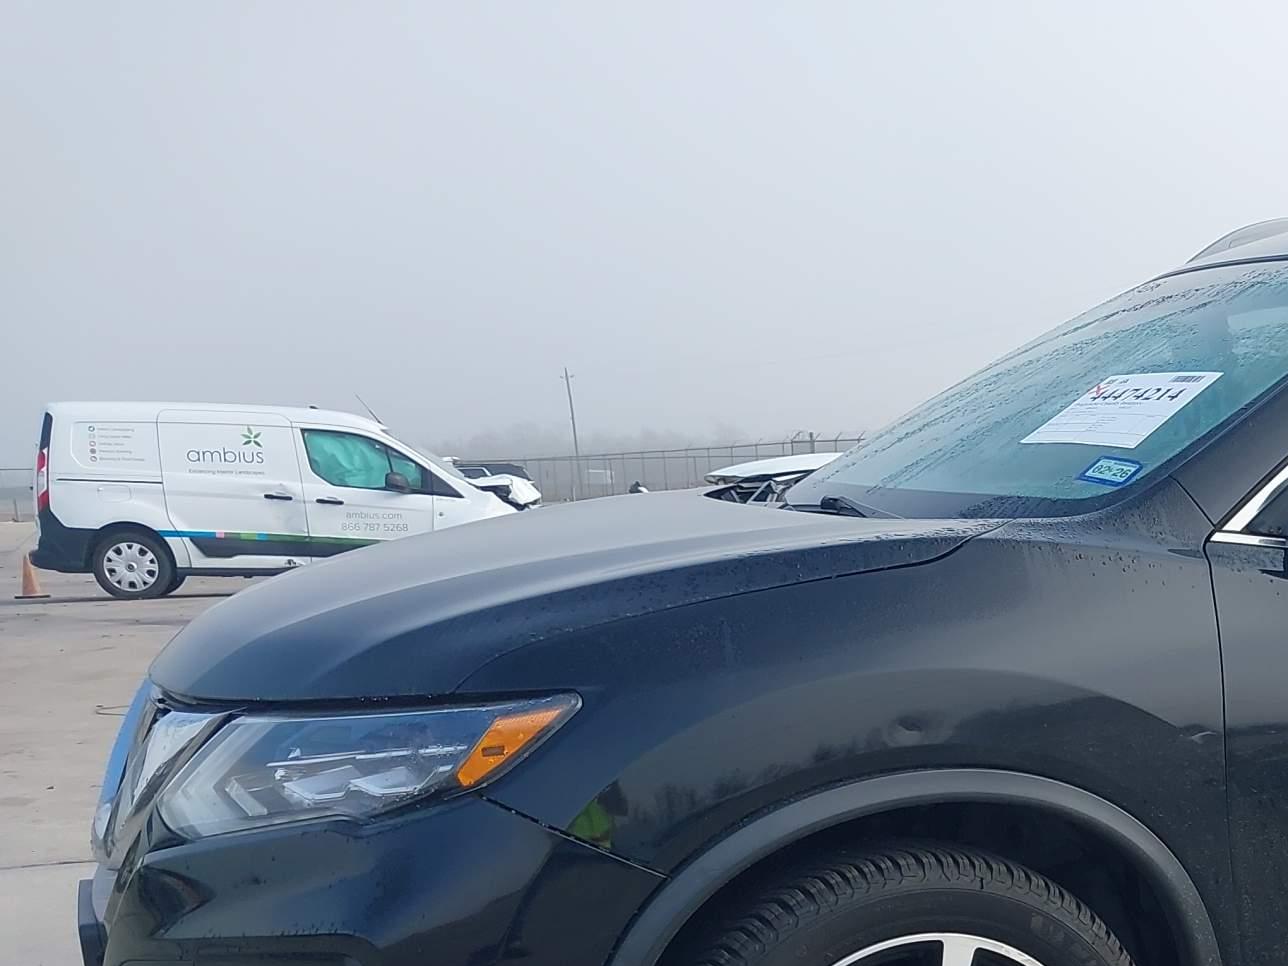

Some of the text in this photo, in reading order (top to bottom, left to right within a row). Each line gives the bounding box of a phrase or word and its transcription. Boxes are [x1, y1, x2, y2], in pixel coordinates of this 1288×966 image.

[1089, 388, 1187, 401] 44474214
[187, 447, 265, 464] ambius
[342, 522, 409, 532] 866 787 5268
